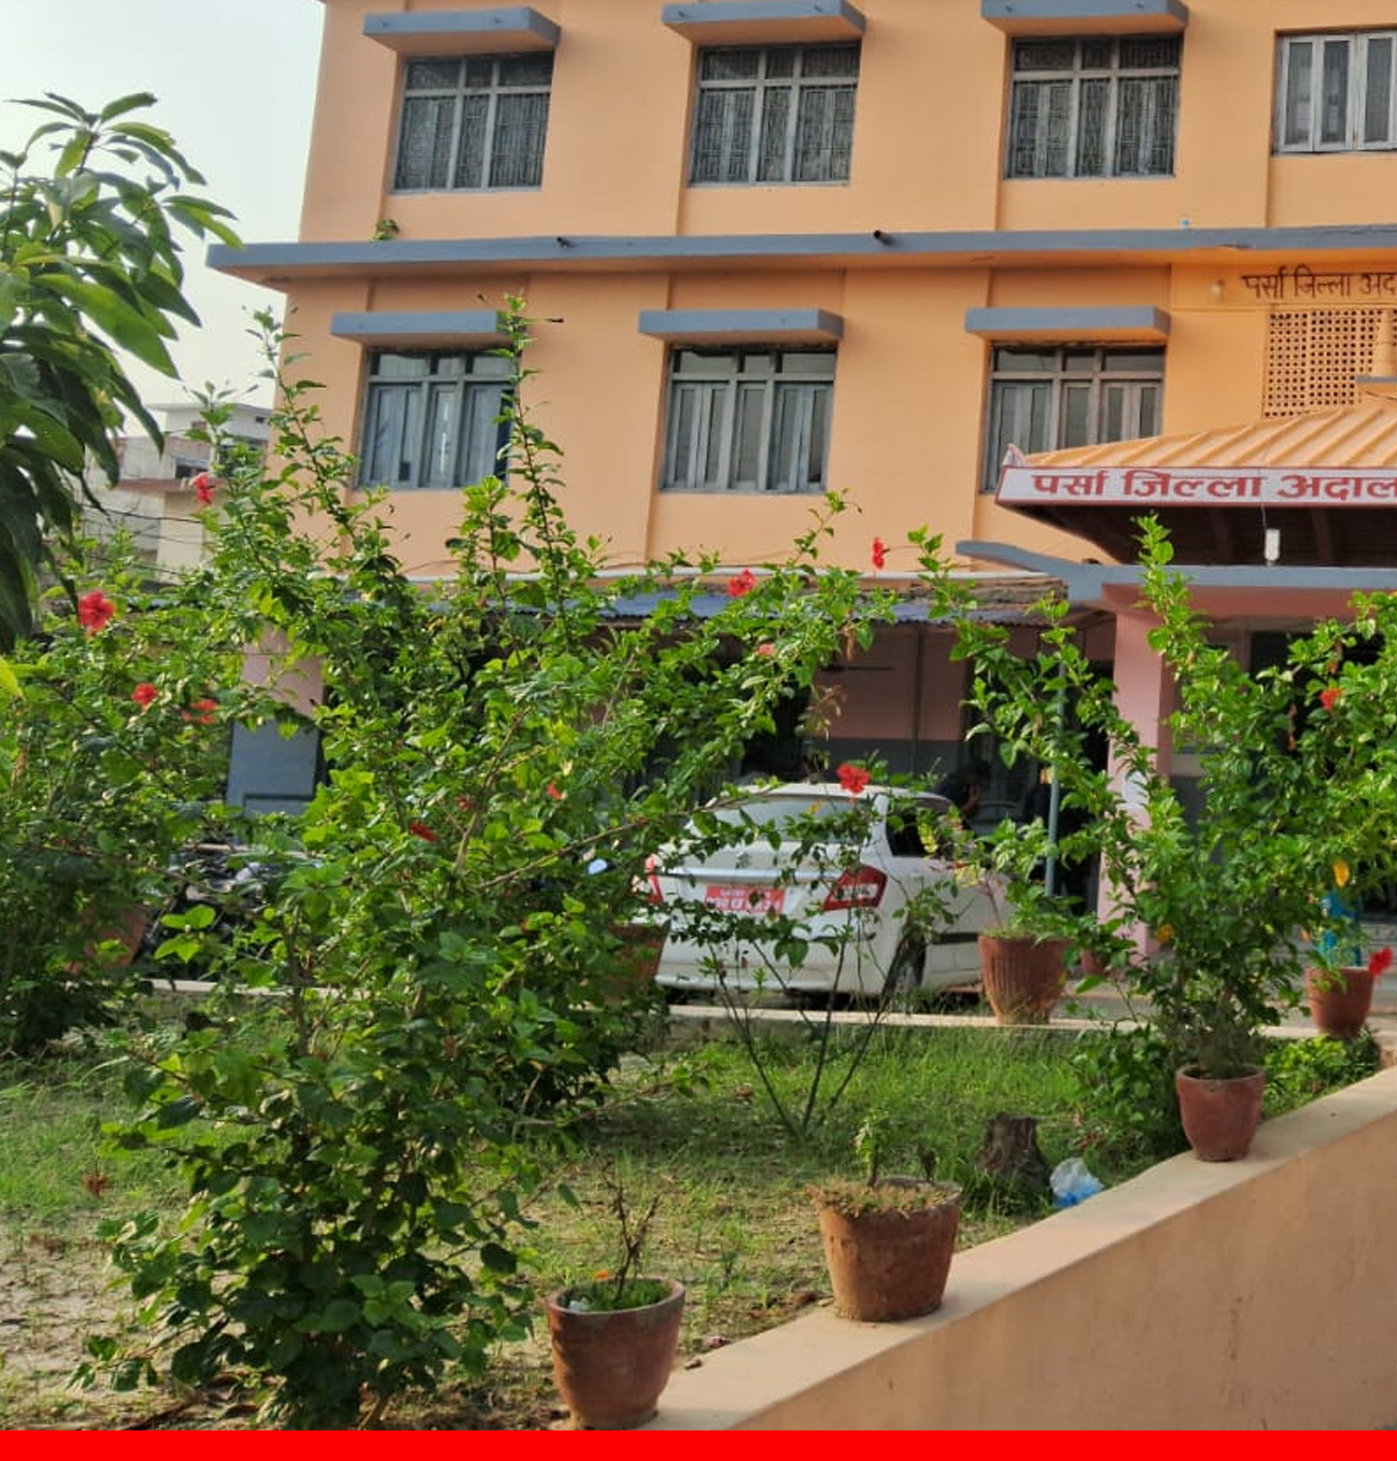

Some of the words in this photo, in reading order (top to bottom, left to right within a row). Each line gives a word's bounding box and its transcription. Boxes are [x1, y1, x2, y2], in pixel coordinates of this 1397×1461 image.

[1242, 265, 1285, 299] पर्सा
[1294, 264, 1350, 298] जिल्ला
[1031, 470, 1108, 497] पर्सा
[1122, 469, 1266, 498] जिल्ला
